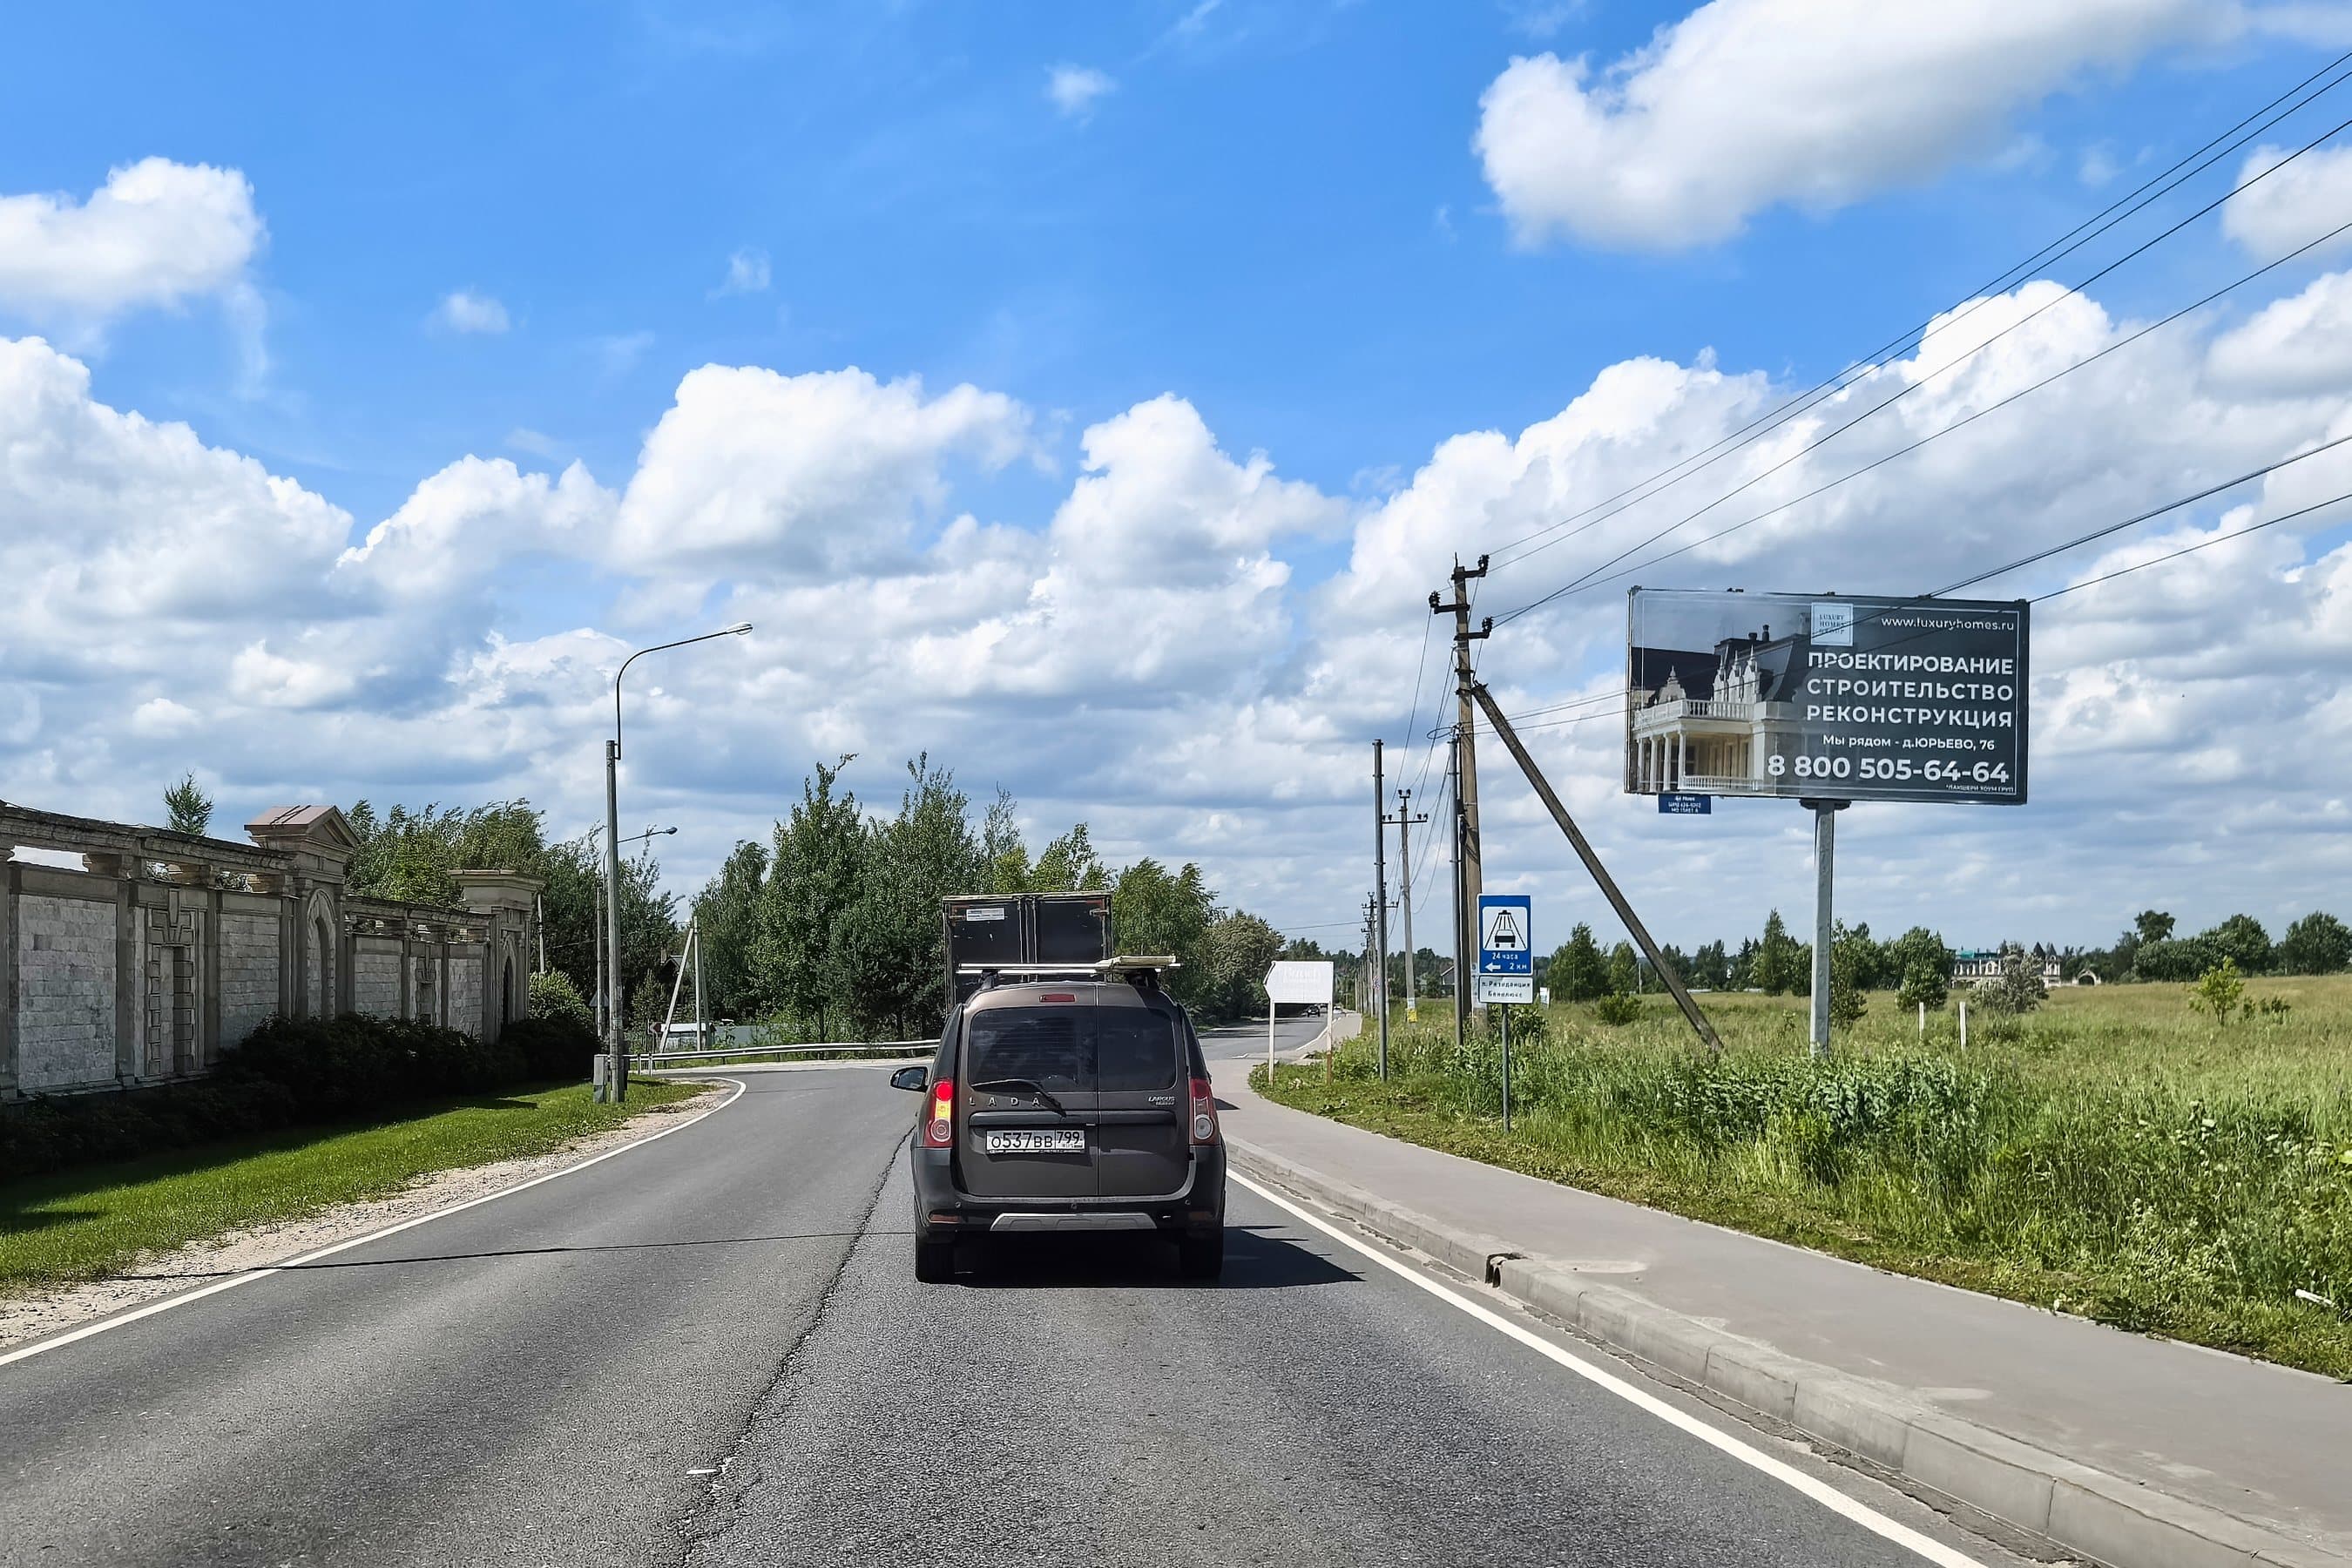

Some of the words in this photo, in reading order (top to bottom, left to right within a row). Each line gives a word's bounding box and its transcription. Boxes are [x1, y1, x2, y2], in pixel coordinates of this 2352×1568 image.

[1881, 617, 2014, 631] www.luxuryhomes.ru
[1808, 652, 2013, 675] ПРОЕКТИРОВАНИЕ
[1807, 678, 2013, 701] СТРОИТЕЛЬСТВО
[1807, 705, 2012, 729] РЕКОНСТРУКЦИЯ
[1822, 734, 1845, 746] Мы
[1848, 738, 1891, 748] рядом
[1979, 740, 1995, 751] 76
[1767, 754, 1785, 777] 8
[1794, 756, 1850, 779] 800
[1859, 758, 2010, 784] 505-64-64
[1509, 962, 1515, 970] 2
[969, 1097, 1040, 1105] LADA
[1057, 1132, 1080, 1144] 799
